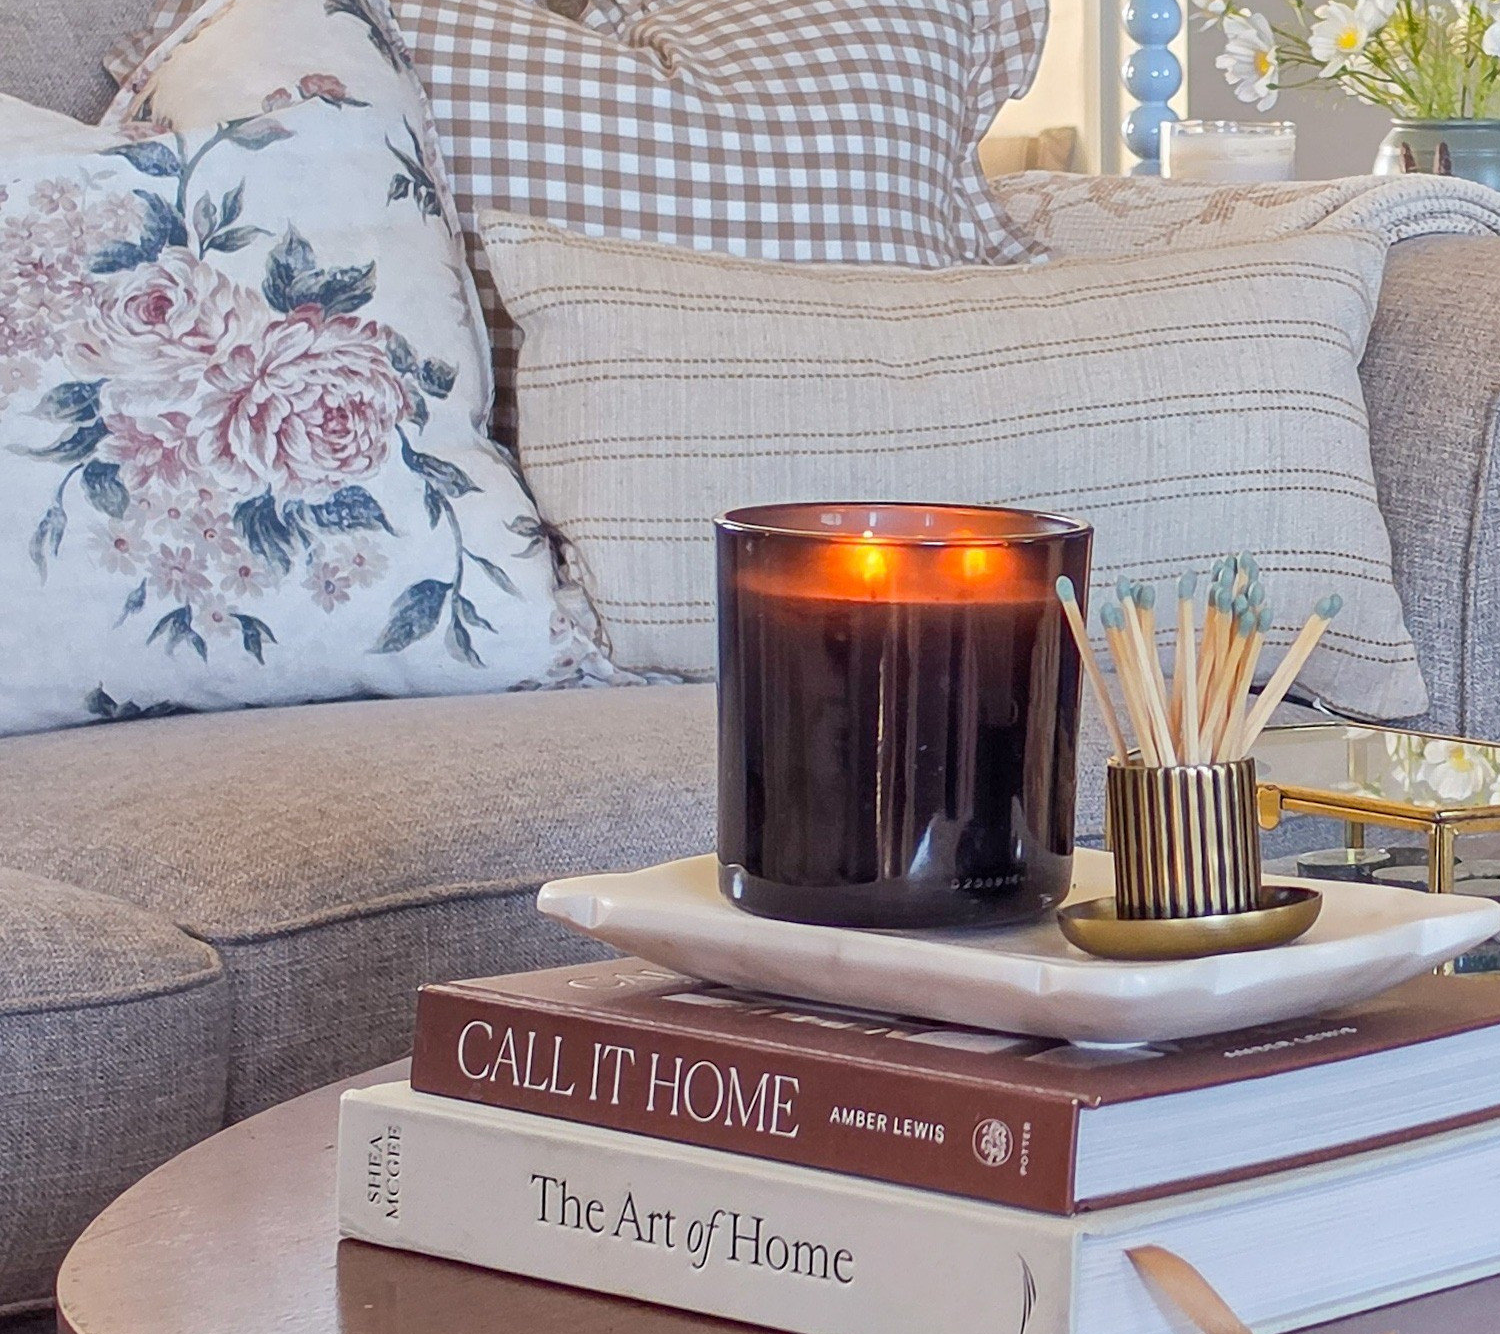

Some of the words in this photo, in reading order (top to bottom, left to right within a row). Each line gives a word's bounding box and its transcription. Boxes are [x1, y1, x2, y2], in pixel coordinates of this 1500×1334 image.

[456, 1020, 576, 1097] CALL
[588, 1042, 636, 1105] IT
[645, 1052, 800, 1139] HOME
[829, 1105, 888, 1134] AMBER
[892, 1116, 946, 1145] LEWIS
[367, 1134, 383, 1205] SHEA
[385, 1126, 402, 1220] MCGEE
[530, 1173, 605, 1234] The
[611, 1190, 676, 1249] Art
[686, 1209, 726, 1269] of
[726, 1211, 854, 1284] Home
